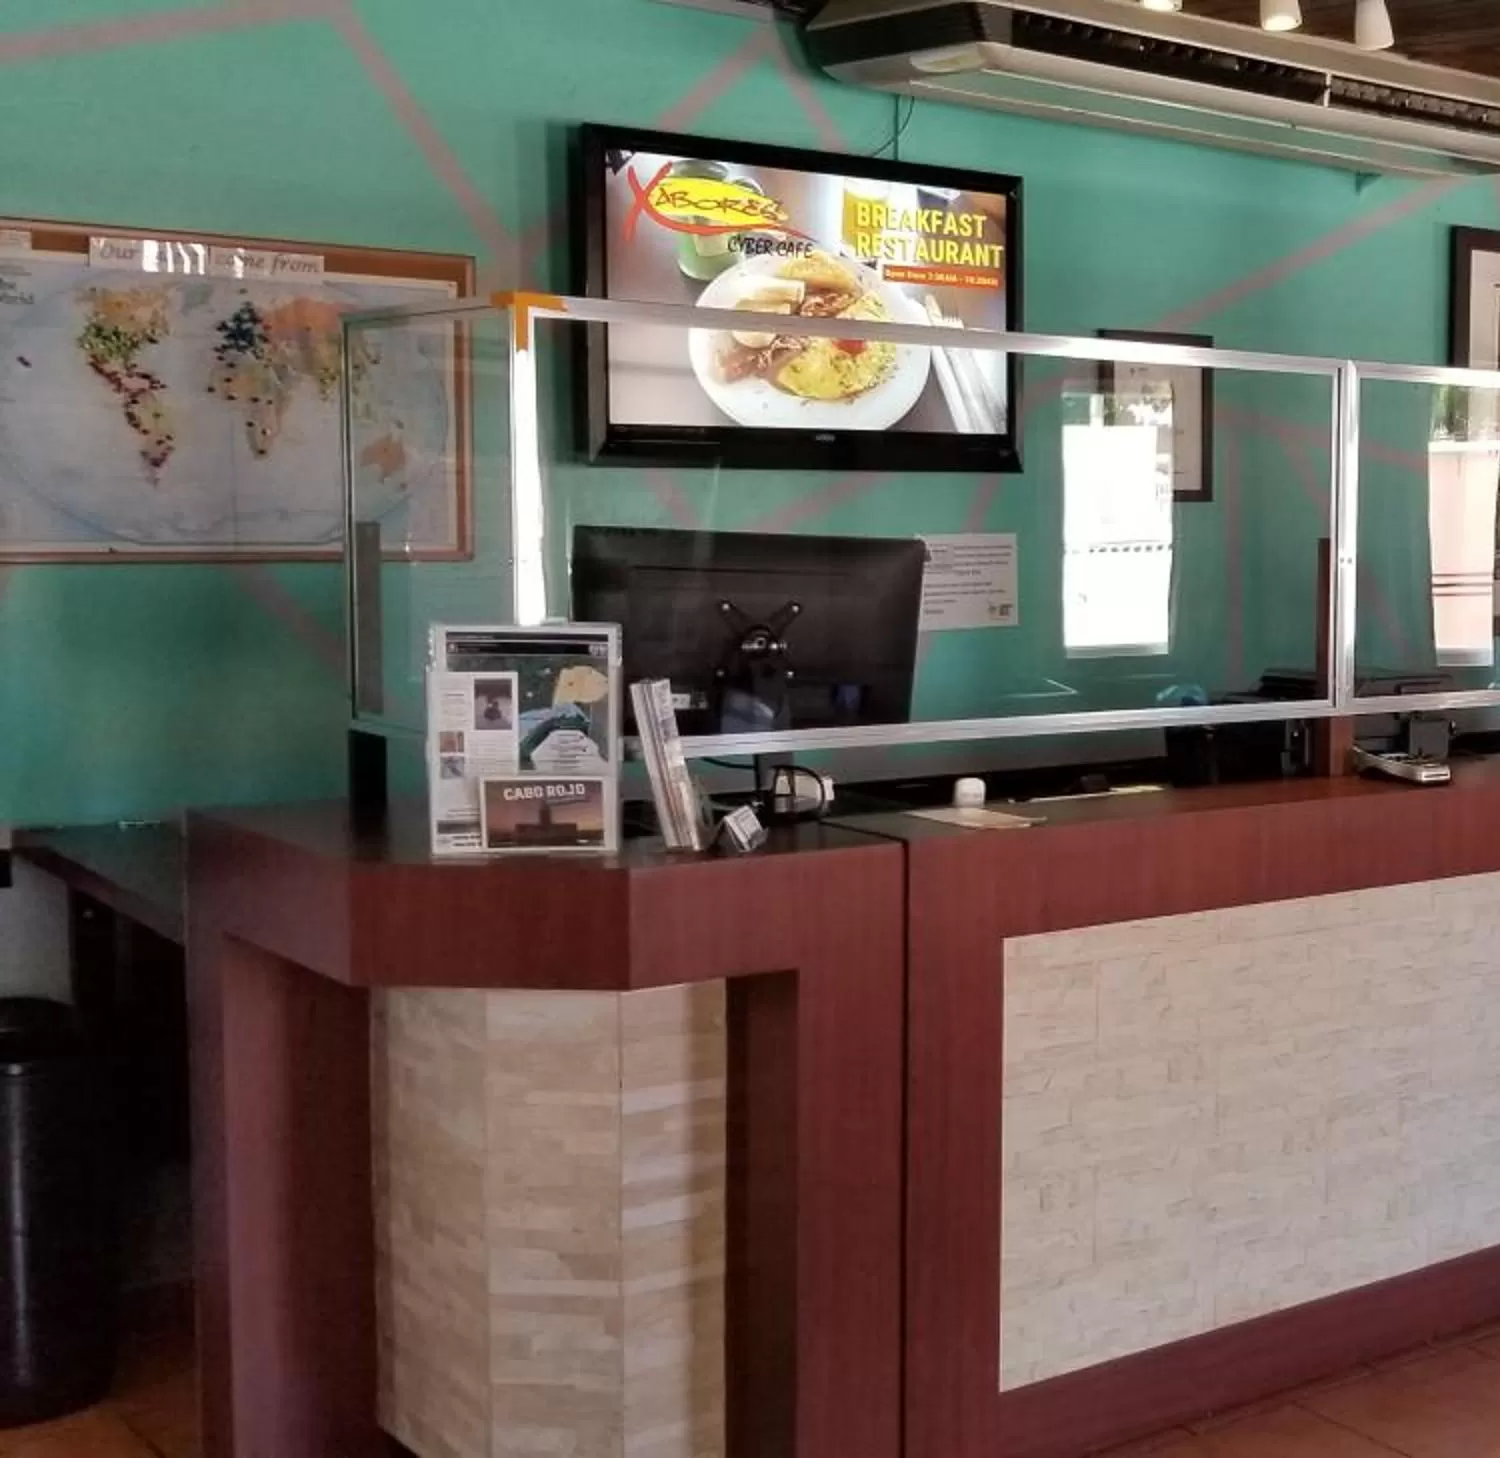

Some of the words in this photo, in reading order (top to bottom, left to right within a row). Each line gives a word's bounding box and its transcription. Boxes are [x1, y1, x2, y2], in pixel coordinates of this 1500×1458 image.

[857, 200, 988, 239] BREAKFAST
[727, 234, 773, 256] CYBER
[776, 240, 815, 259] CAFE
[857, 231, 1005, 269] RESTAURANT
[270, 254, 321, 275] from
[503, 786, 544, 800] CABO
[546, 784, 585, 798] ROJO
